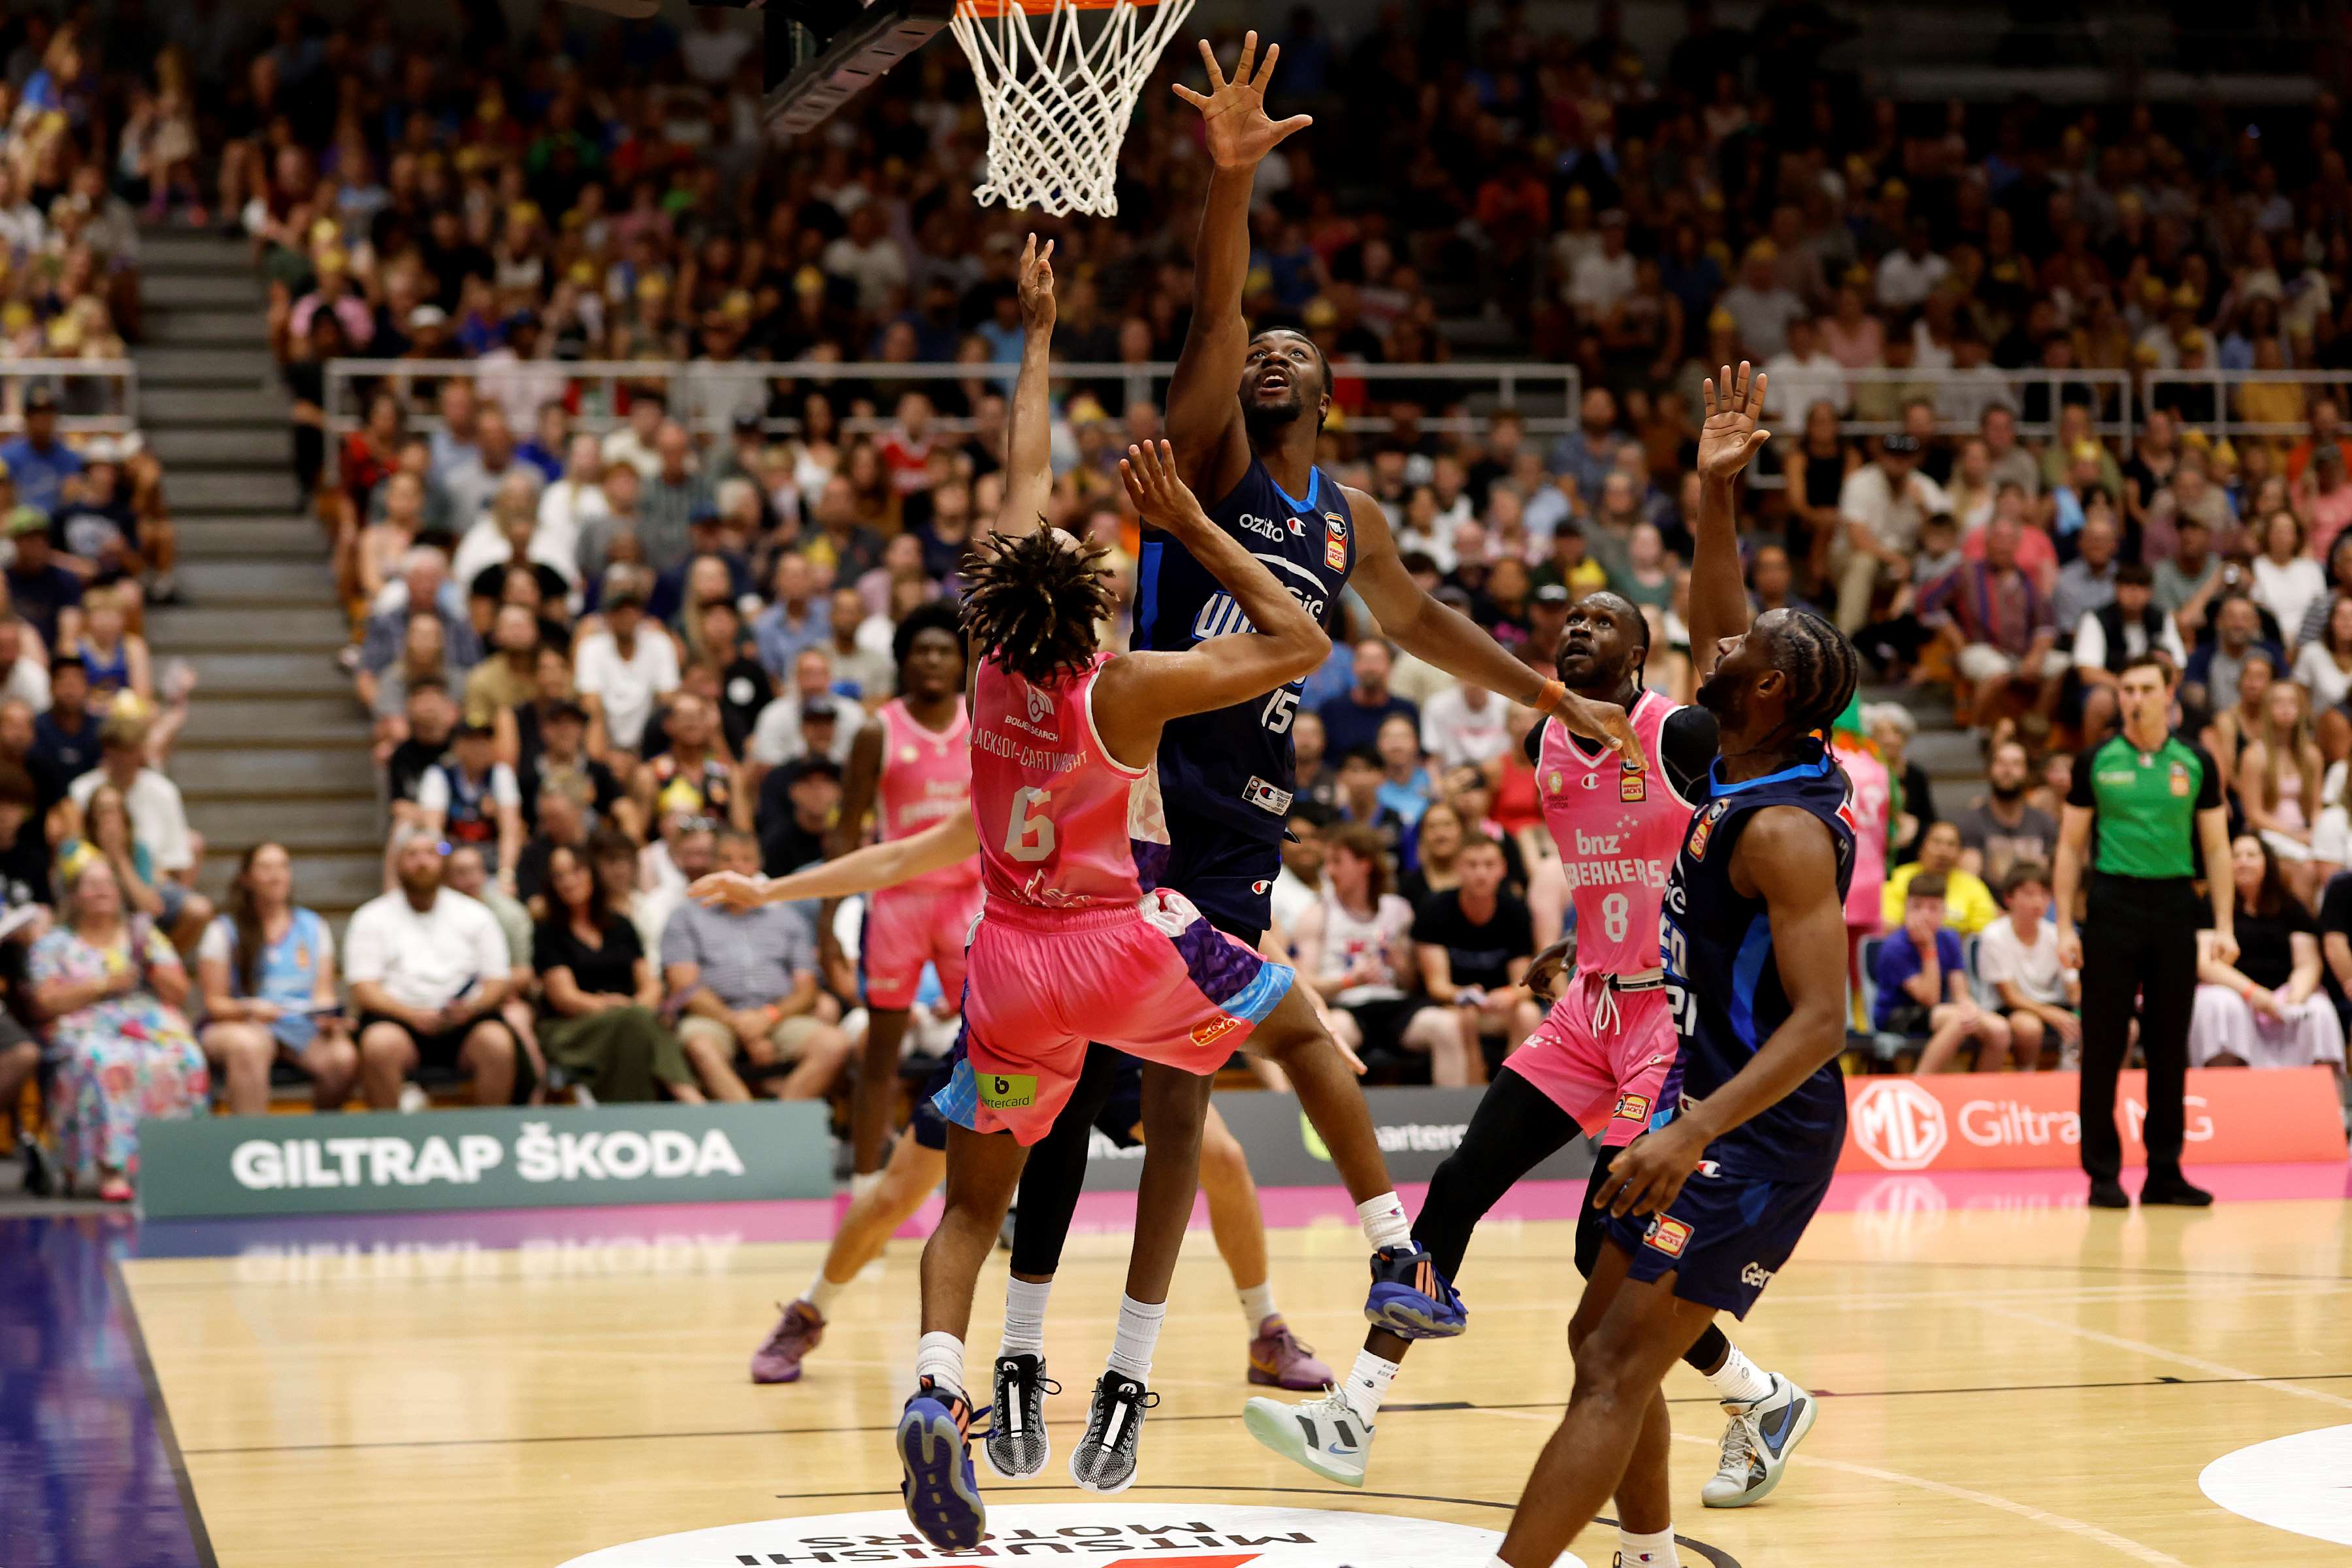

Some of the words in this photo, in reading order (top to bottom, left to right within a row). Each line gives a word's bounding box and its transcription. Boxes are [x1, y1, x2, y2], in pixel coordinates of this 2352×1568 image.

[1239, 514, 1284, 542] ozito
[1030, 726, 1058, 742] SEARCH
[1262, 688, 1301, 734] 15
[1004, 785, 1056, 862] 6
[1575, 828, 1620, 855] bnz
[1602, 893, 1629, 943] 8
[1863, 1090, 1936, 1159] MG
[1959, 1100, 2082, 1147] Giltra
[231, 1135, 503, 1189] GILTRAP
[515, 1122, 745, 1182] ŠKODA
[798, 1521, 1217, 1549] MOTRS
